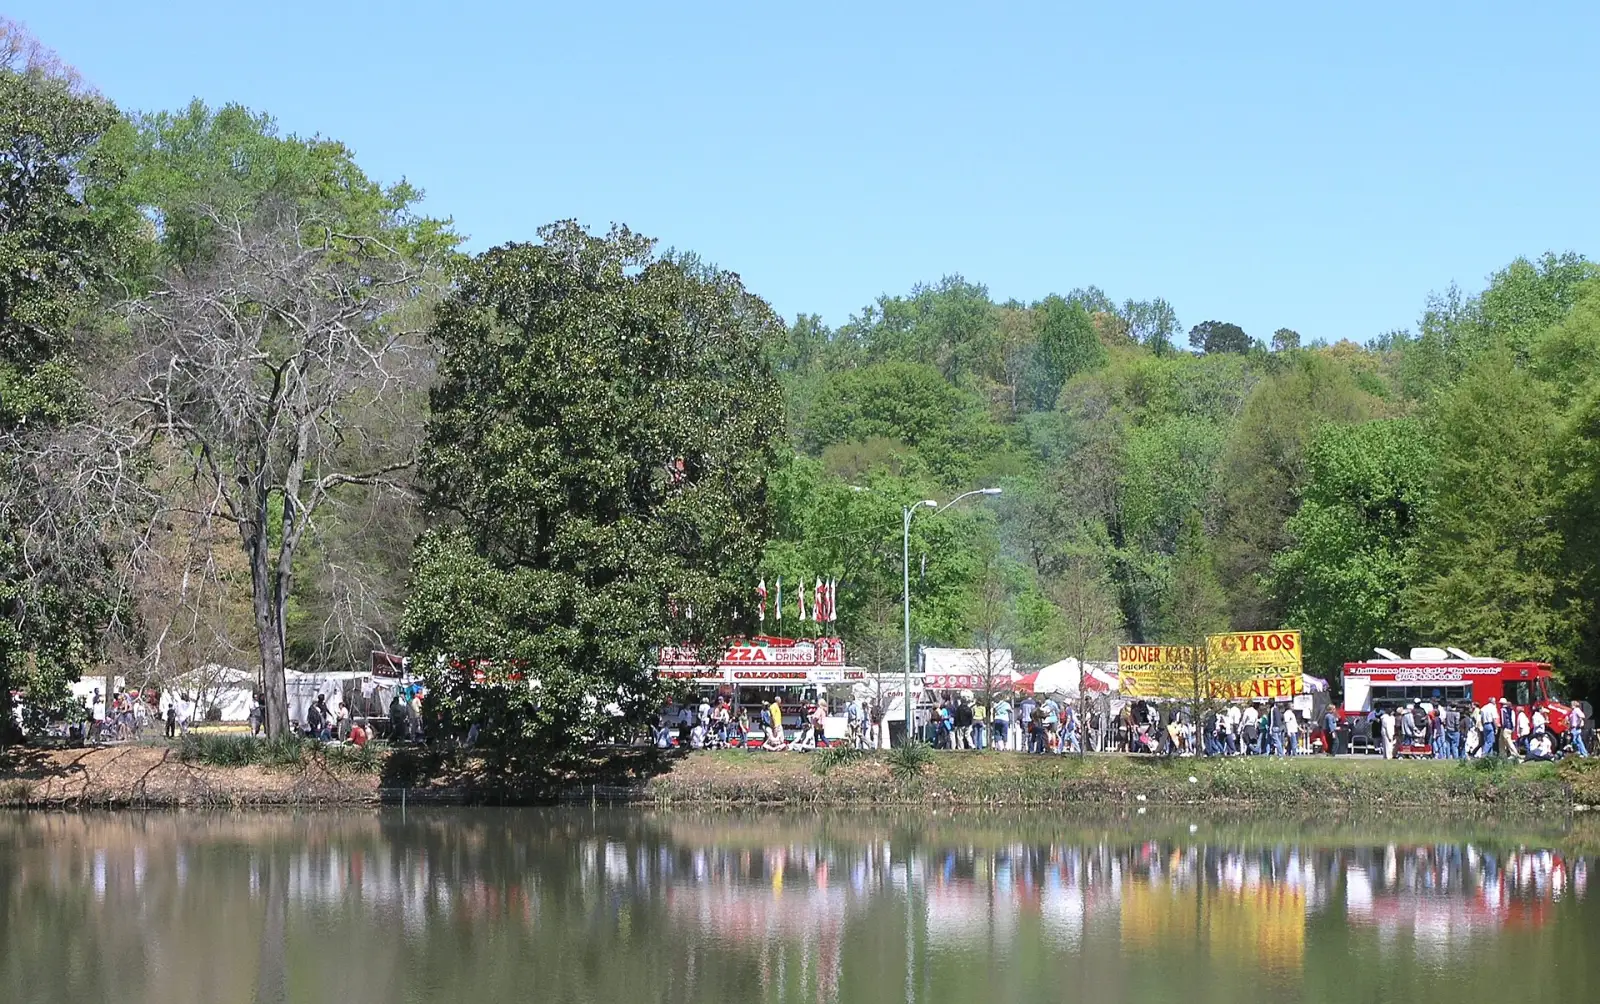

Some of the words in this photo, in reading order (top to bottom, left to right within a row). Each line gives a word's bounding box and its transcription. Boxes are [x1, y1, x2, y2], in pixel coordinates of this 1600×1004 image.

[1221, 634, 1294, 652] GYROS
[726, 649, 767, 661] ZZA
[775, 653, 812, 661] DRINKS
[823, 648, 839, 661] PIZZA
[1120, 646, 1160, 662] DONER
[733, 671, 807, 679] CALZONES
[1209, 677, 1302, 698] FALAFEL
